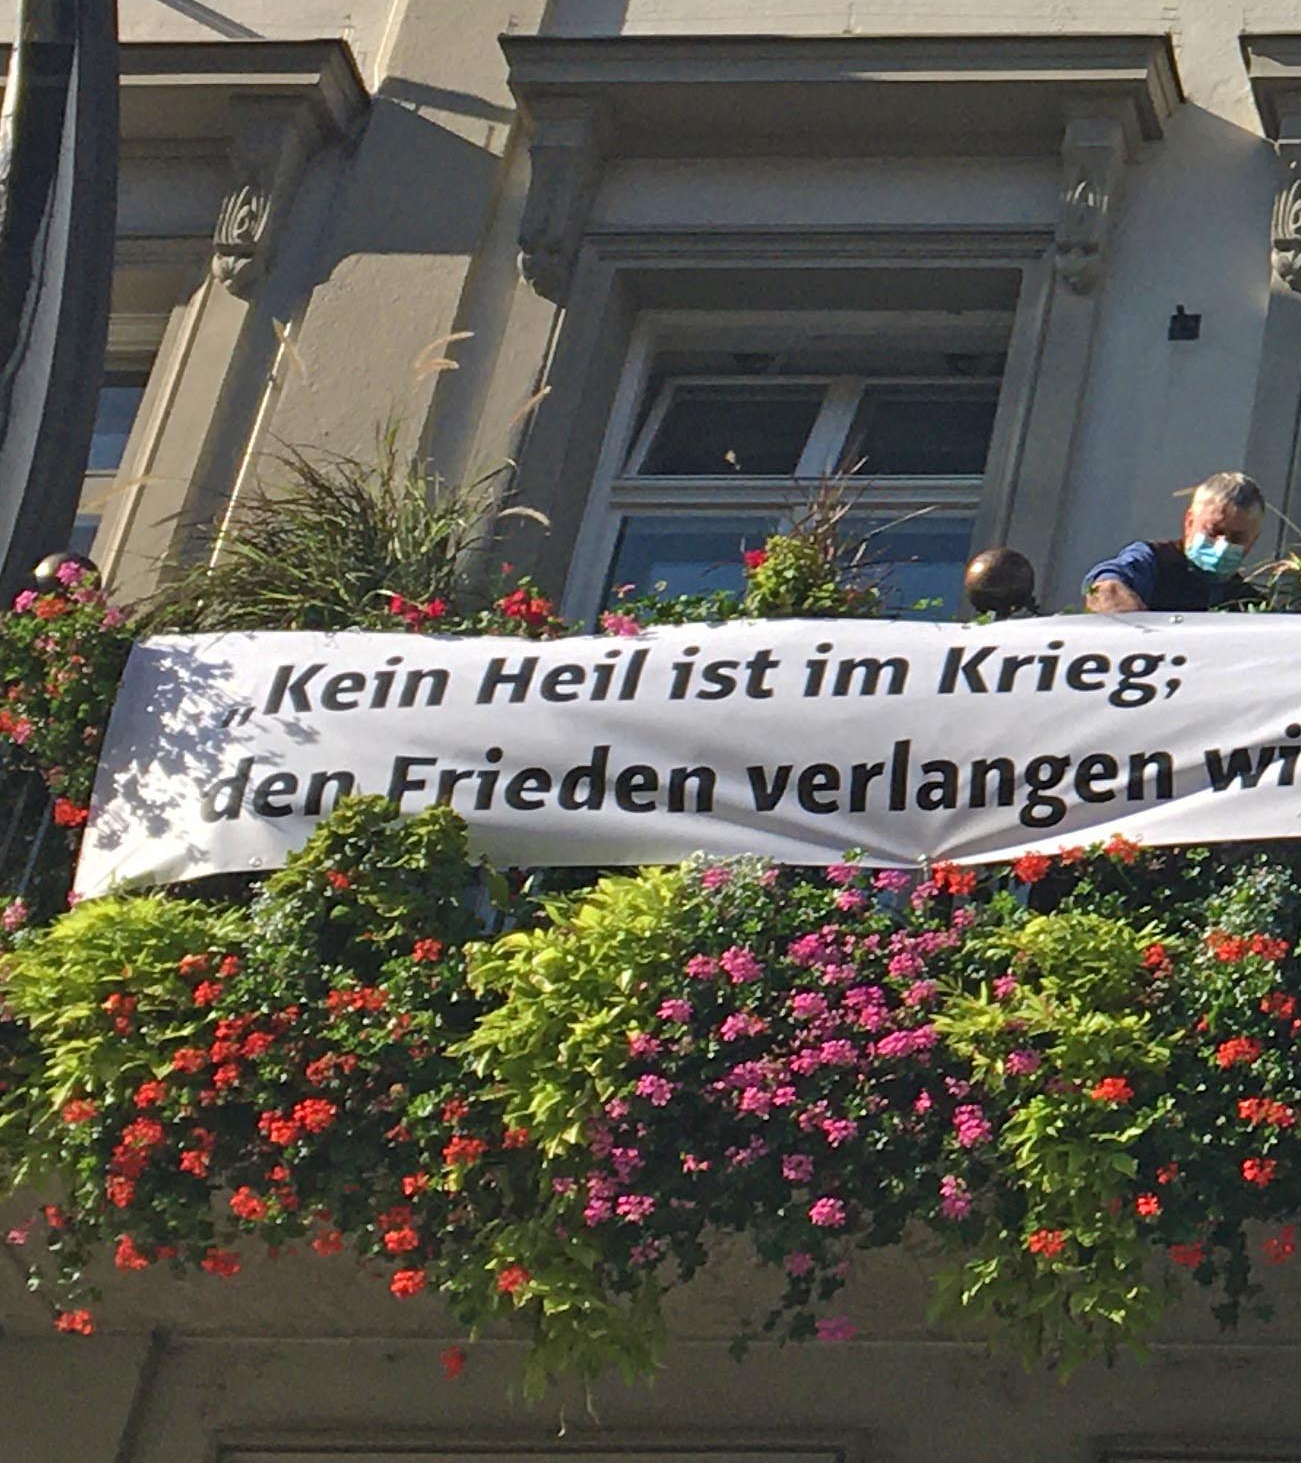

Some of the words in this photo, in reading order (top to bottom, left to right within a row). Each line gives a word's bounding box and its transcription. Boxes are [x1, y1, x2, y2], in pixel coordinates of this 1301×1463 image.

[221, 655, 451, 728] „Kein
[476, 645, 651, 706] Heil
[668, 644, 781, 702] ist
[802, 641, 912, 698] im
[936, 640, 1188, 708] Krieg;
[200, 755, 357, 825] den
[385, 744, 718, 815] Frieden
[745, 738, 1176, 830] verlangen
